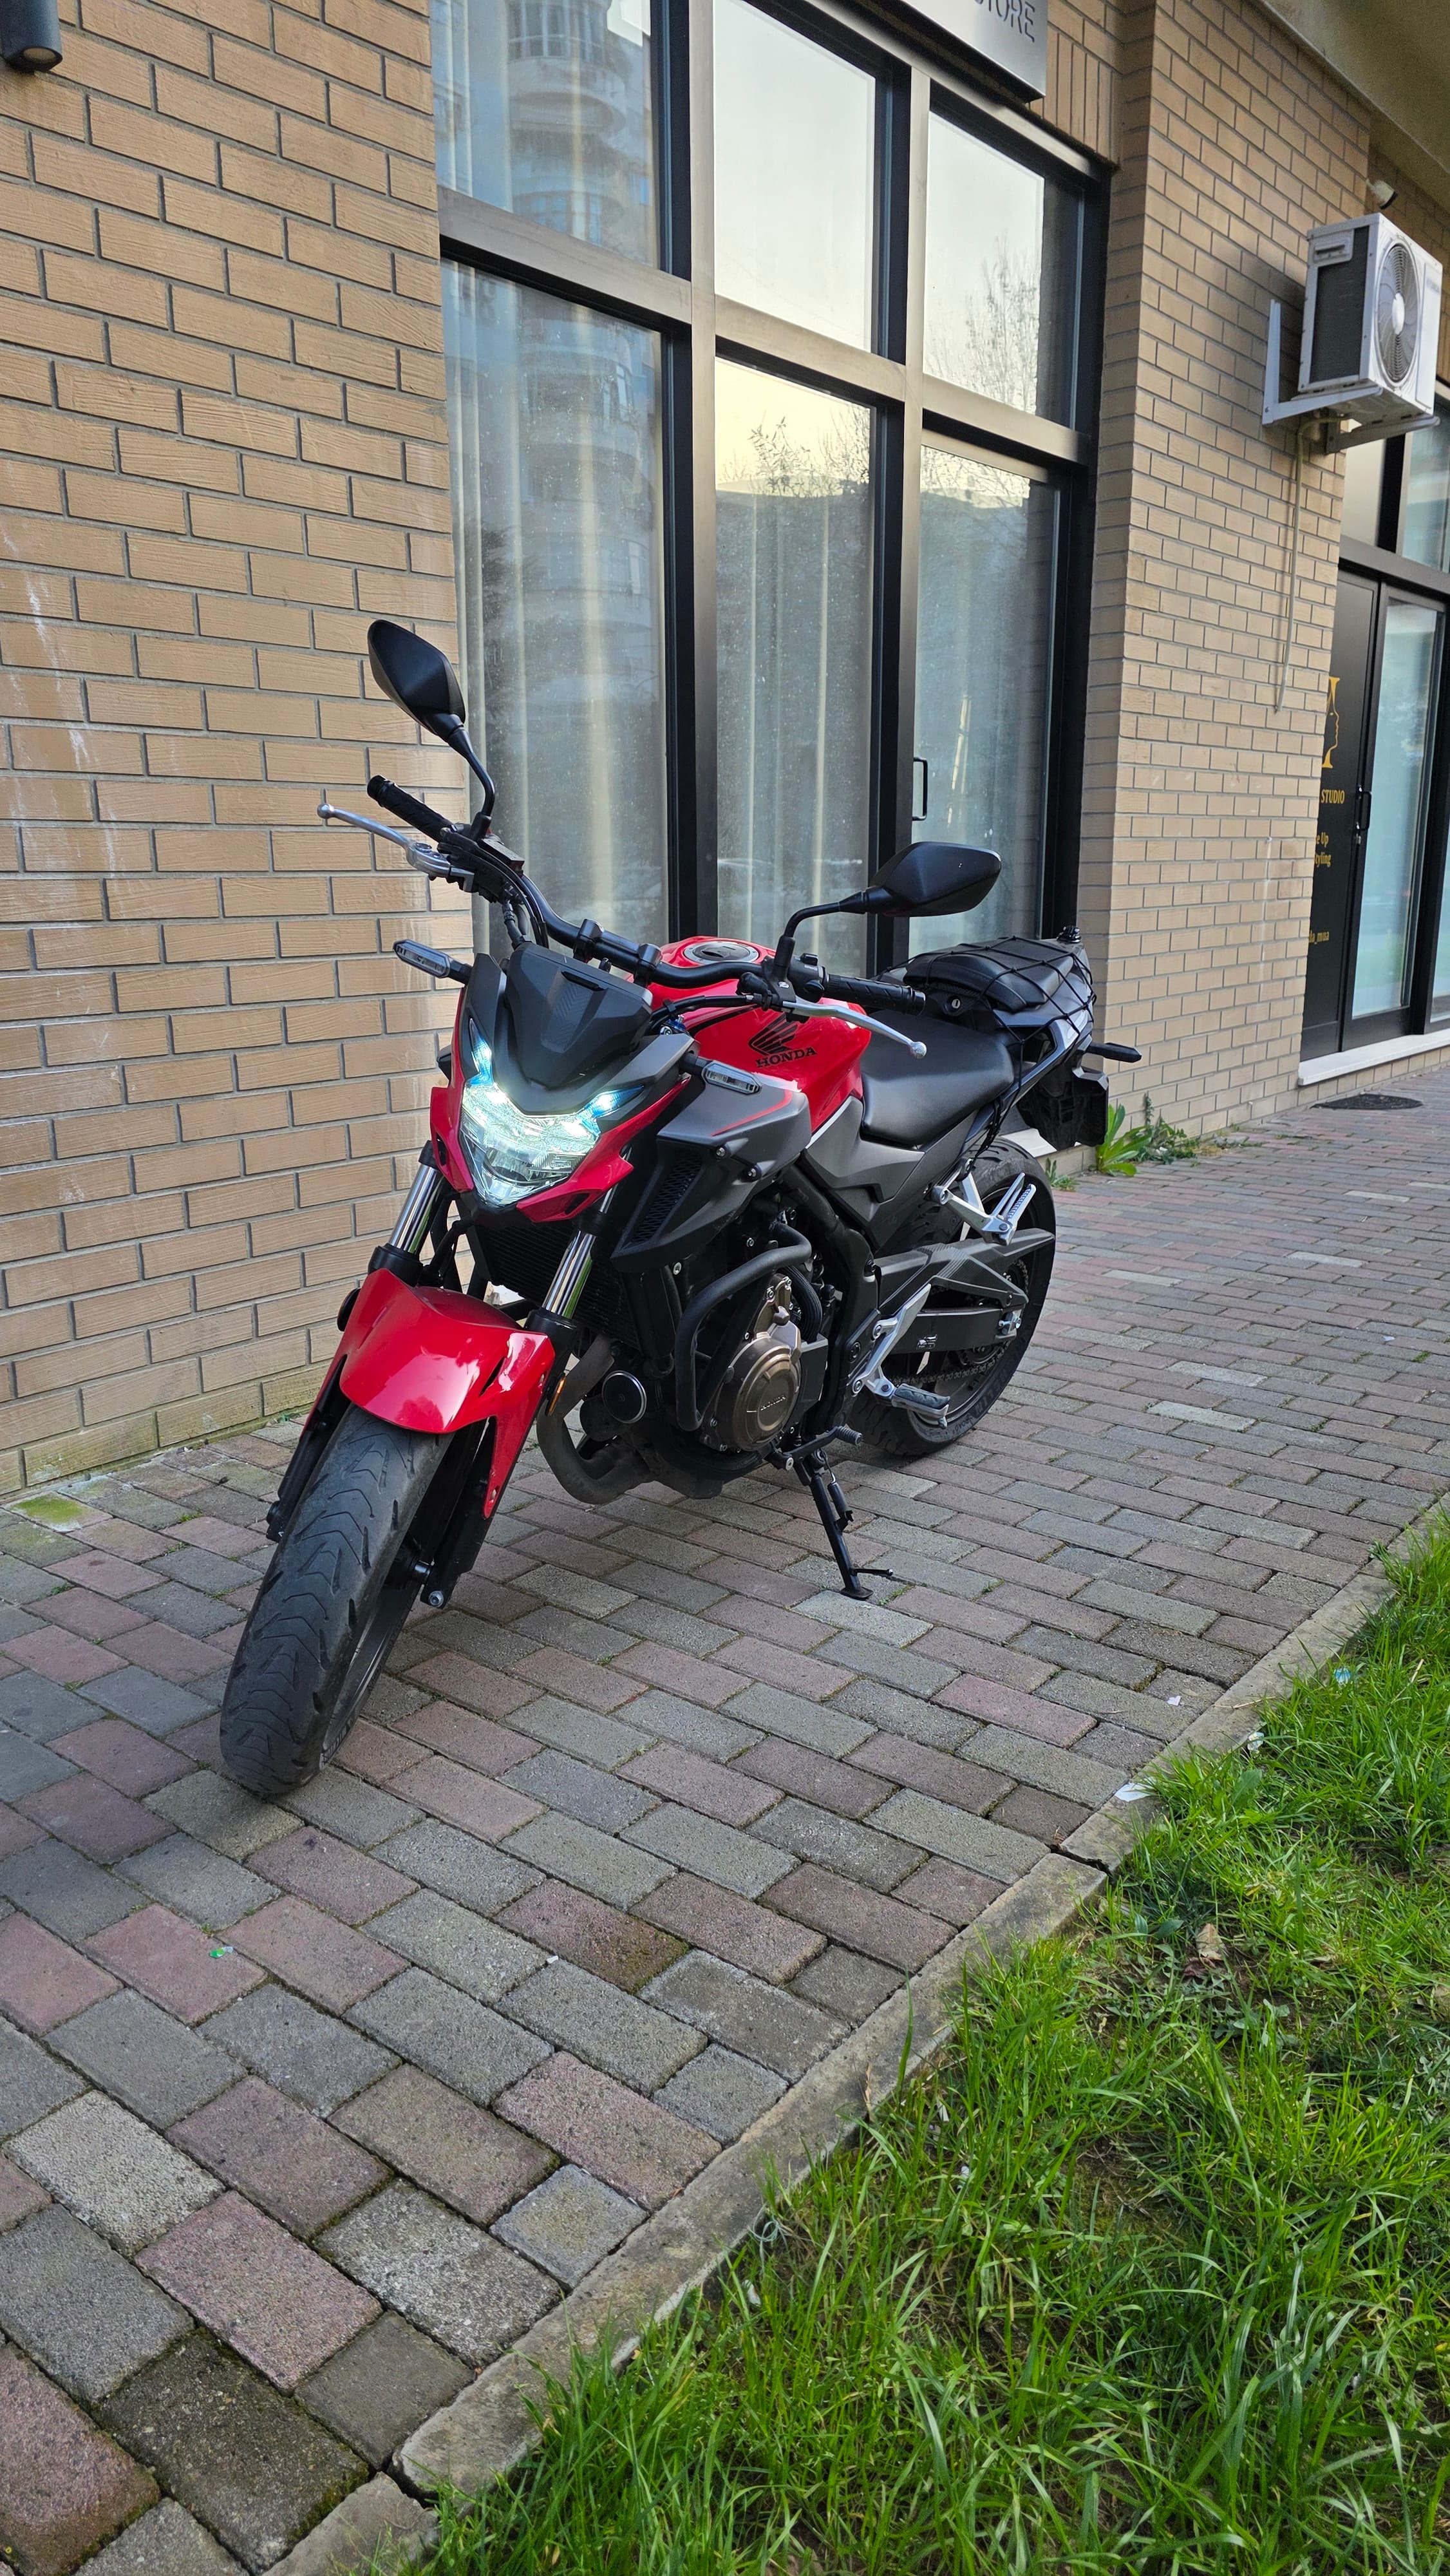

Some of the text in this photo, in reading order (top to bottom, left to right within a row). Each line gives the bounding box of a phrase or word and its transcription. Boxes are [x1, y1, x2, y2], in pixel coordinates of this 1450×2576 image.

[974, 0, 1035, 43] ORE
[1321, 789, 1345, 804] STUDIO
[1321, 831, 1329, 848] Up
[755, 1046, 817, 1068] HONDA
